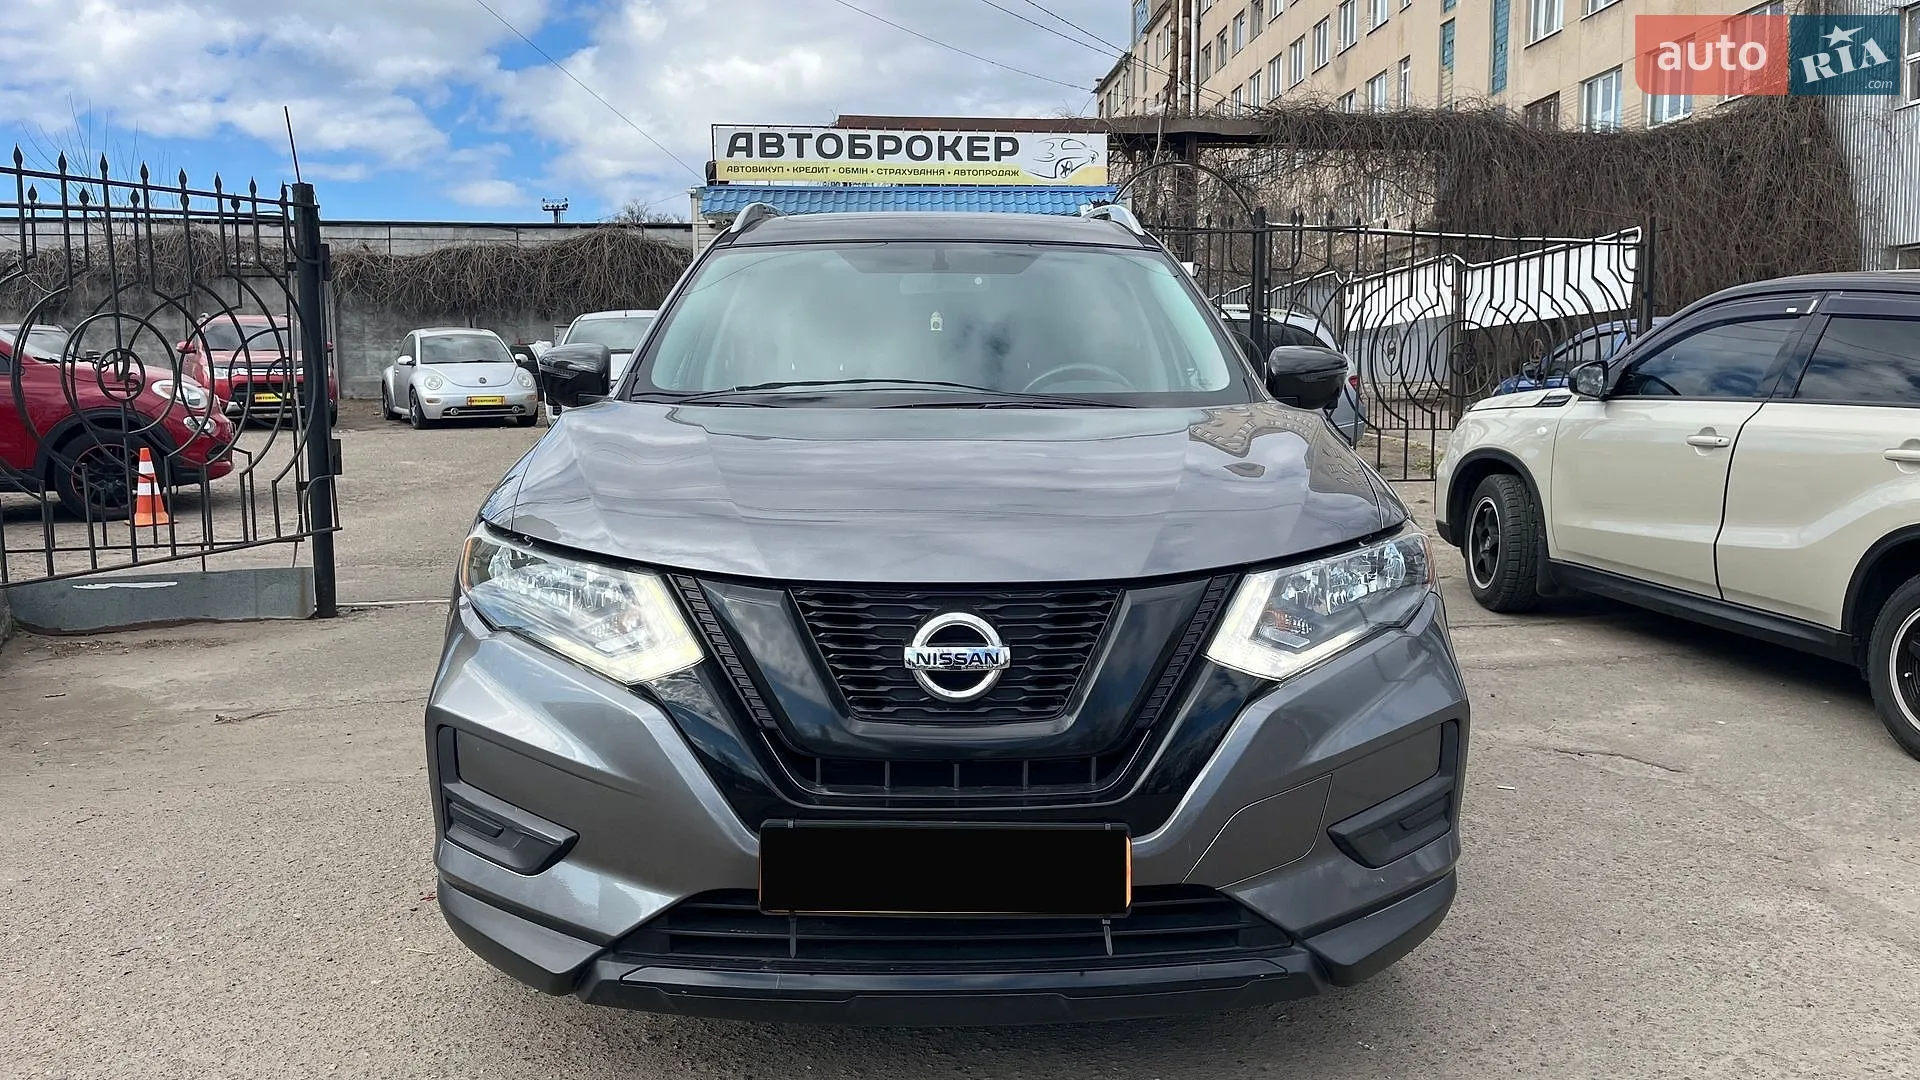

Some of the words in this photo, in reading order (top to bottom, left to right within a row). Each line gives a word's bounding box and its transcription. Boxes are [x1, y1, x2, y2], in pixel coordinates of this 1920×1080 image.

[726, 132, 1020, 162] АВТОБРОКЕР
[726, 165, 784, 174] АВТОВИКУП
[792, 166, 830, 174] КРЕДИТ
[838, 167, 868, 175] ОБМІН
[876, 167, 945, 176] СТРАХУВАННЯ
[953, 169, 1020, 177] АВТОПРОДАЖ
[916, 652, 999, 666] NISSAN
